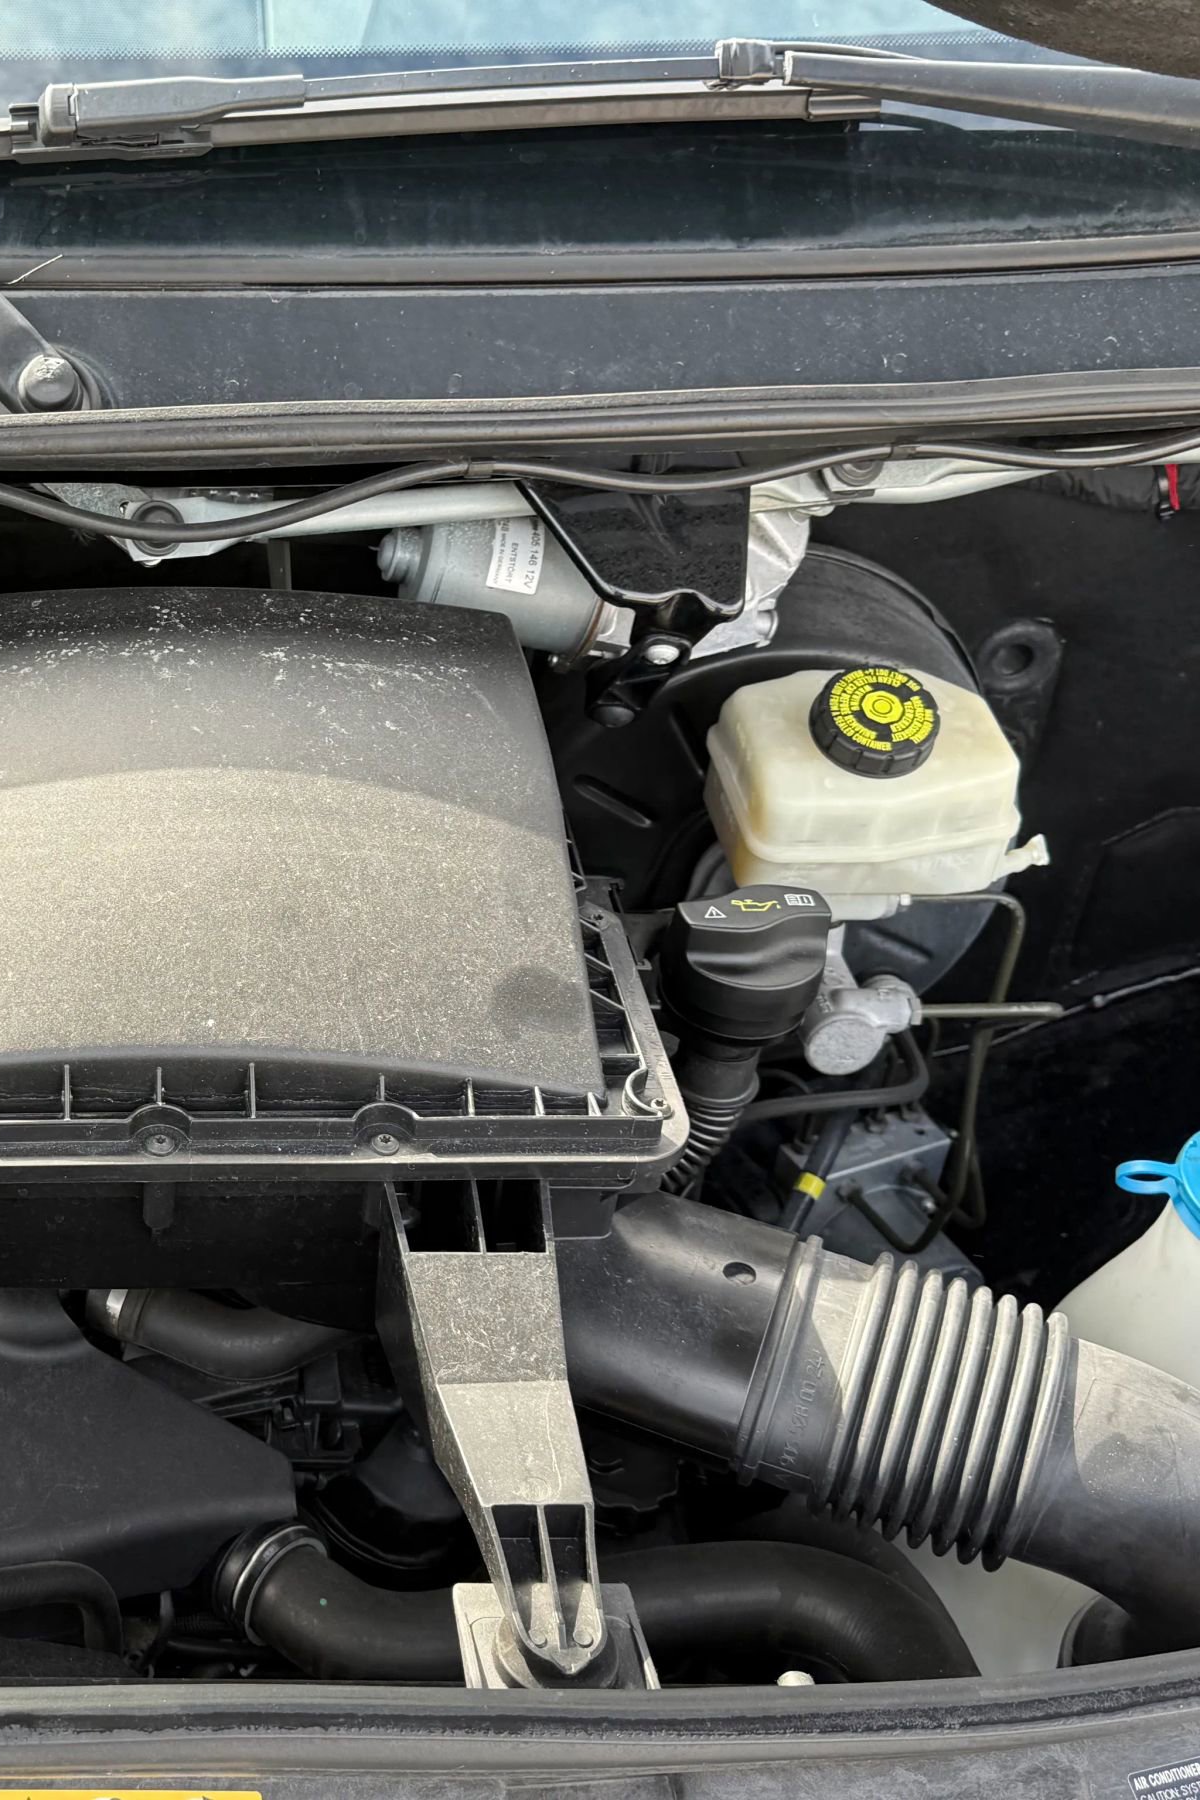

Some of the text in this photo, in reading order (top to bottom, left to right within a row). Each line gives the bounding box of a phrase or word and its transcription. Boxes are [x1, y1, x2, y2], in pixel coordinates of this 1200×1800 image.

[528, 550, 539, 566] 146
[523, 570, 535, 589] 12V
[875, 668, 890, 677] DOT
[890, 671, 908, 684] ONLY
[852, 675, 877, 687] FILLER
[877, 676, 901, 688] CLEAN
[905, 680, 921, 692] USE
[829, 694, 841, 711] FROM
[839, 692, 852, 716] BEFORE
[833, 715, 856, 737] SEALED
[843, 714, 878, 740] REMOVING
[852, 733, 893, 752] CONTAINER
[1134, 1776, 1150, 1791] AIR
